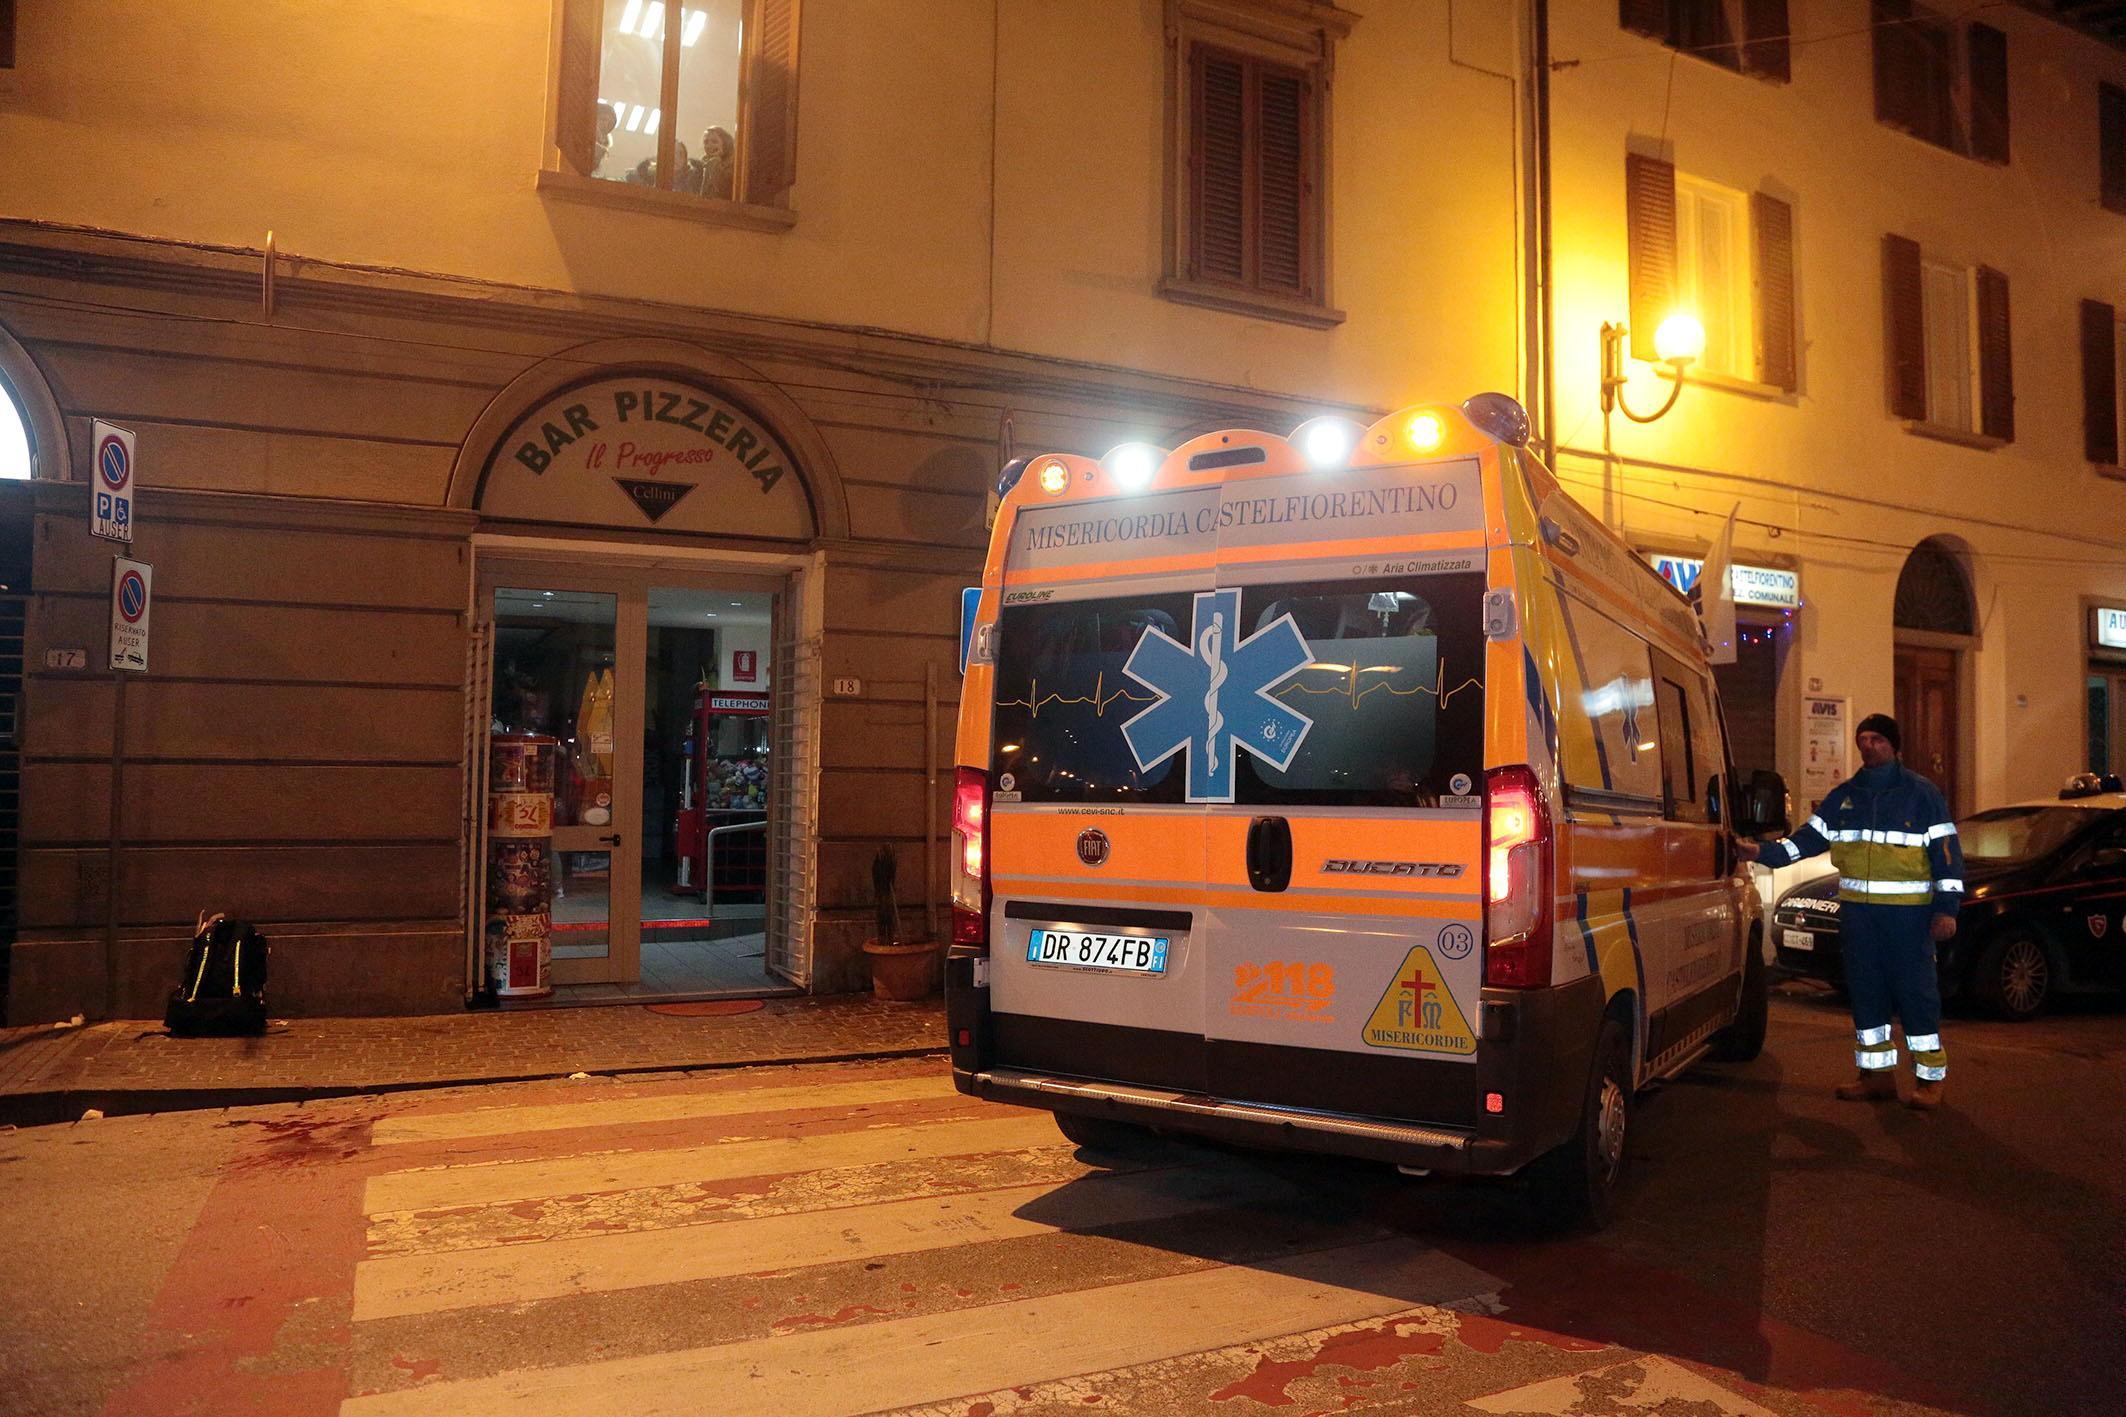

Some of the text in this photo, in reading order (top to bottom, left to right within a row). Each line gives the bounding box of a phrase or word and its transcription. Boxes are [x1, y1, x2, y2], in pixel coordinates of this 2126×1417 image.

[514, 390, 785, 494] BAR PIZZERIA
[586, 442, 714, 475] Il Progresso
[633, 485, 676, 501] Cellini
[1026, 511, 1189, 551] MISERICORDIA
[1196, 483, 1457, 534] CASTELFIORENTINO
[99, 519, 129, 541] AUSER
[1383, 559, 1471, 573] Aria Climatizzata
[1007, 590, 1054, 601] EUROLINE
[1748, 590, 1794, 604] COMUNALE
[114, 622, 146, 637] RISERVATO
[117, 636, 140, 648] AUSER
[57, 652, 76, 666] 17
[839, 680, 855, 693] 18
[713, 699, 769, 709] TELEPHON
[1812, 702, 1837, 715] AVIS
[1058, 807, 1125, 815] www.cevi-snc.it
[1083, 840, 1102, 856] FIAT
[1324, 860, 1462, 876] DUCATO
[1442, 932, 1468, 952] 03
[1043, 934, 1070, 961] DR
[1079, 937, 1151, 967] 874FB
[1263, 961, 1336, 998] 118
[1371, 1029, 1468, 1049] MISERICORDIE
